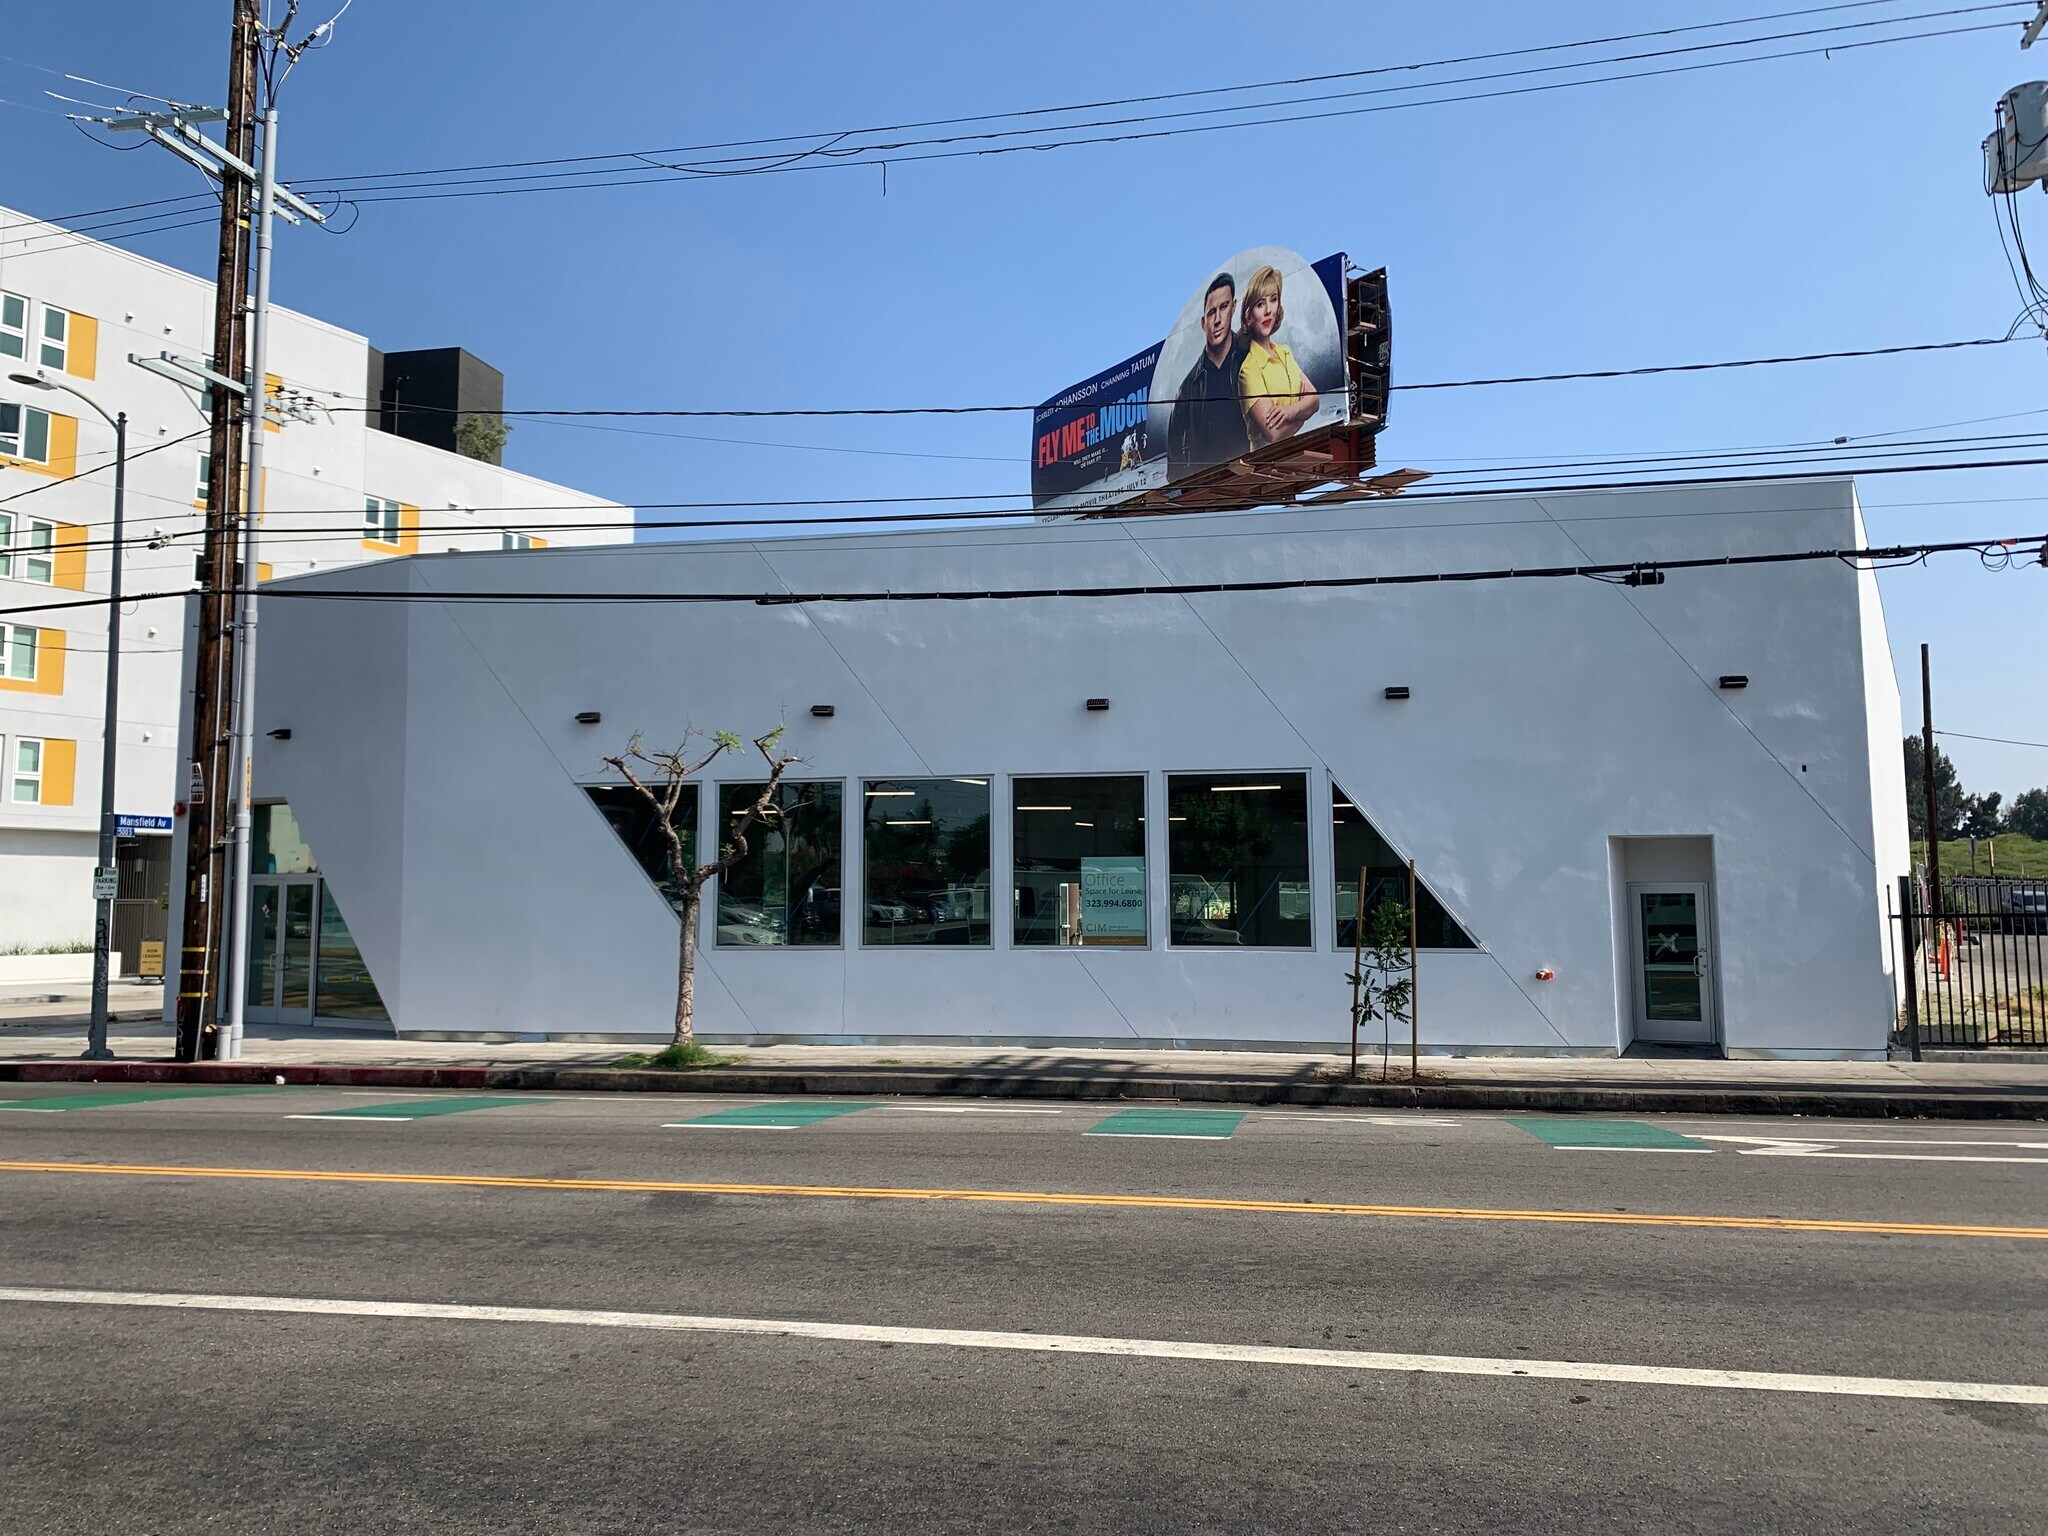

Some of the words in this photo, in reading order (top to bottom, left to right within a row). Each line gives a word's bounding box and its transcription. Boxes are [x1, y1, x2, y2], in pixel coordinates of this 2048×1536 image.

[1100, 369, 1130, 390] CHANNING
[1130, 353, 1155, 375] TATUM
[1086, 426, 1100, 448] THE
[1100, 385, 1148, 441] MOON
[1038, 427, 1061, 469] FLY
[1062, 417, 1086, 458] ME
[1086, 412, 1096, 431] TO
[1126, 481, 1139, 491] JULY
[1140, 477, 1147, 487] 12
[120, 816, 156, 828] Mansfield
[157, 818, 167, 828] Av
[1084, 873, 1125, 887] Office
[1085, 888, 1106, 897] Space
[1085, 899, 1143, 908] 323.994.6800
[1085, 923, 1107, 932] CIM
